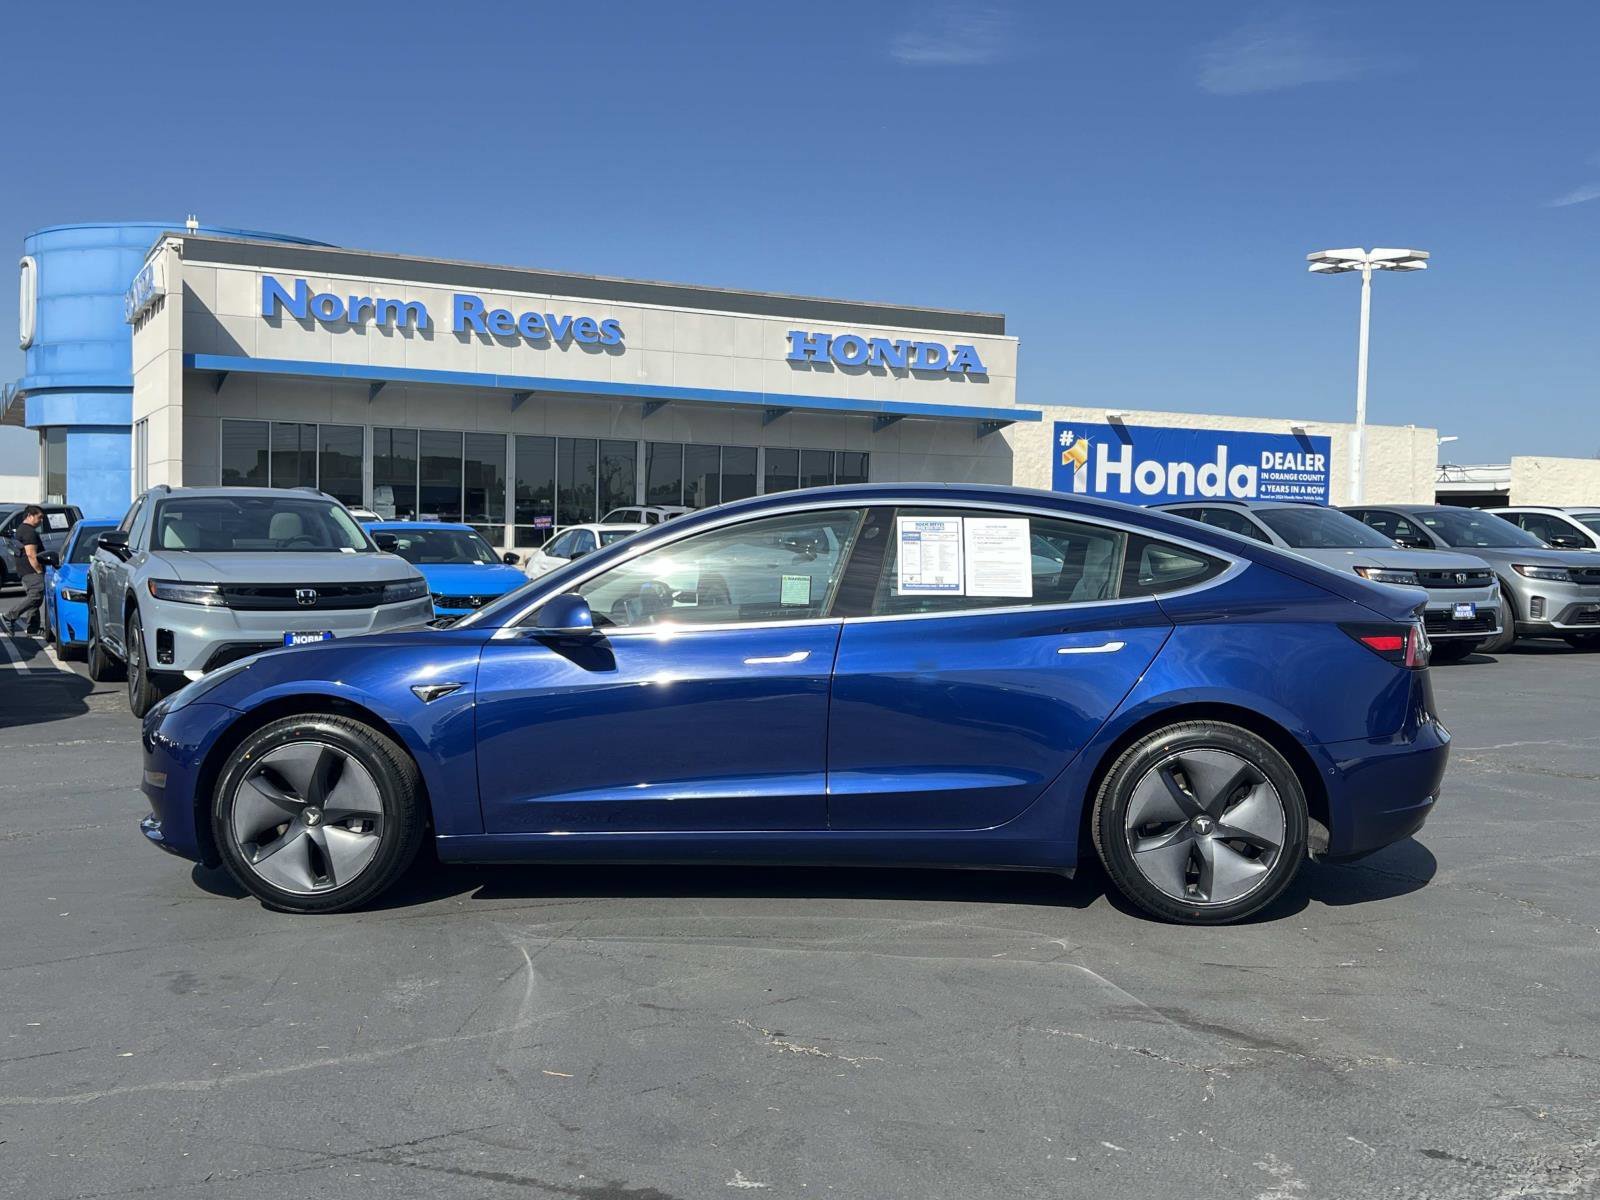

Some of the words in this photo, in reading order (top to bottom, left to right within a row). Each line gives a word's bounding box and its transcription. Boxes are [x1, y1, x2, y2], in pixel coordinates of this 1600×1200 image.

[262, 275, 429, 329] Norm
[453, 293, 624, 345] Reeves
[787, 330, 988, 374] HONDA
[1095, 443, 1258, 498] Honda
[1261, 451, 1326, 472] DEALER
[1261, 472, 1269, 480] IN
[1270, 473, 1298, 481] ORANGE
[1298, 474, 1325, 482] COUNTY
[1260, 485, 1266, 493] 4
[1267, 485, 1290, 493] YEARS
[1290, 486, 1299, 494] IN
[1300, 486, 1306, 494] A
[1306, 487, 1325, 495] ROW
[292, 635, 324, 644] NORM
